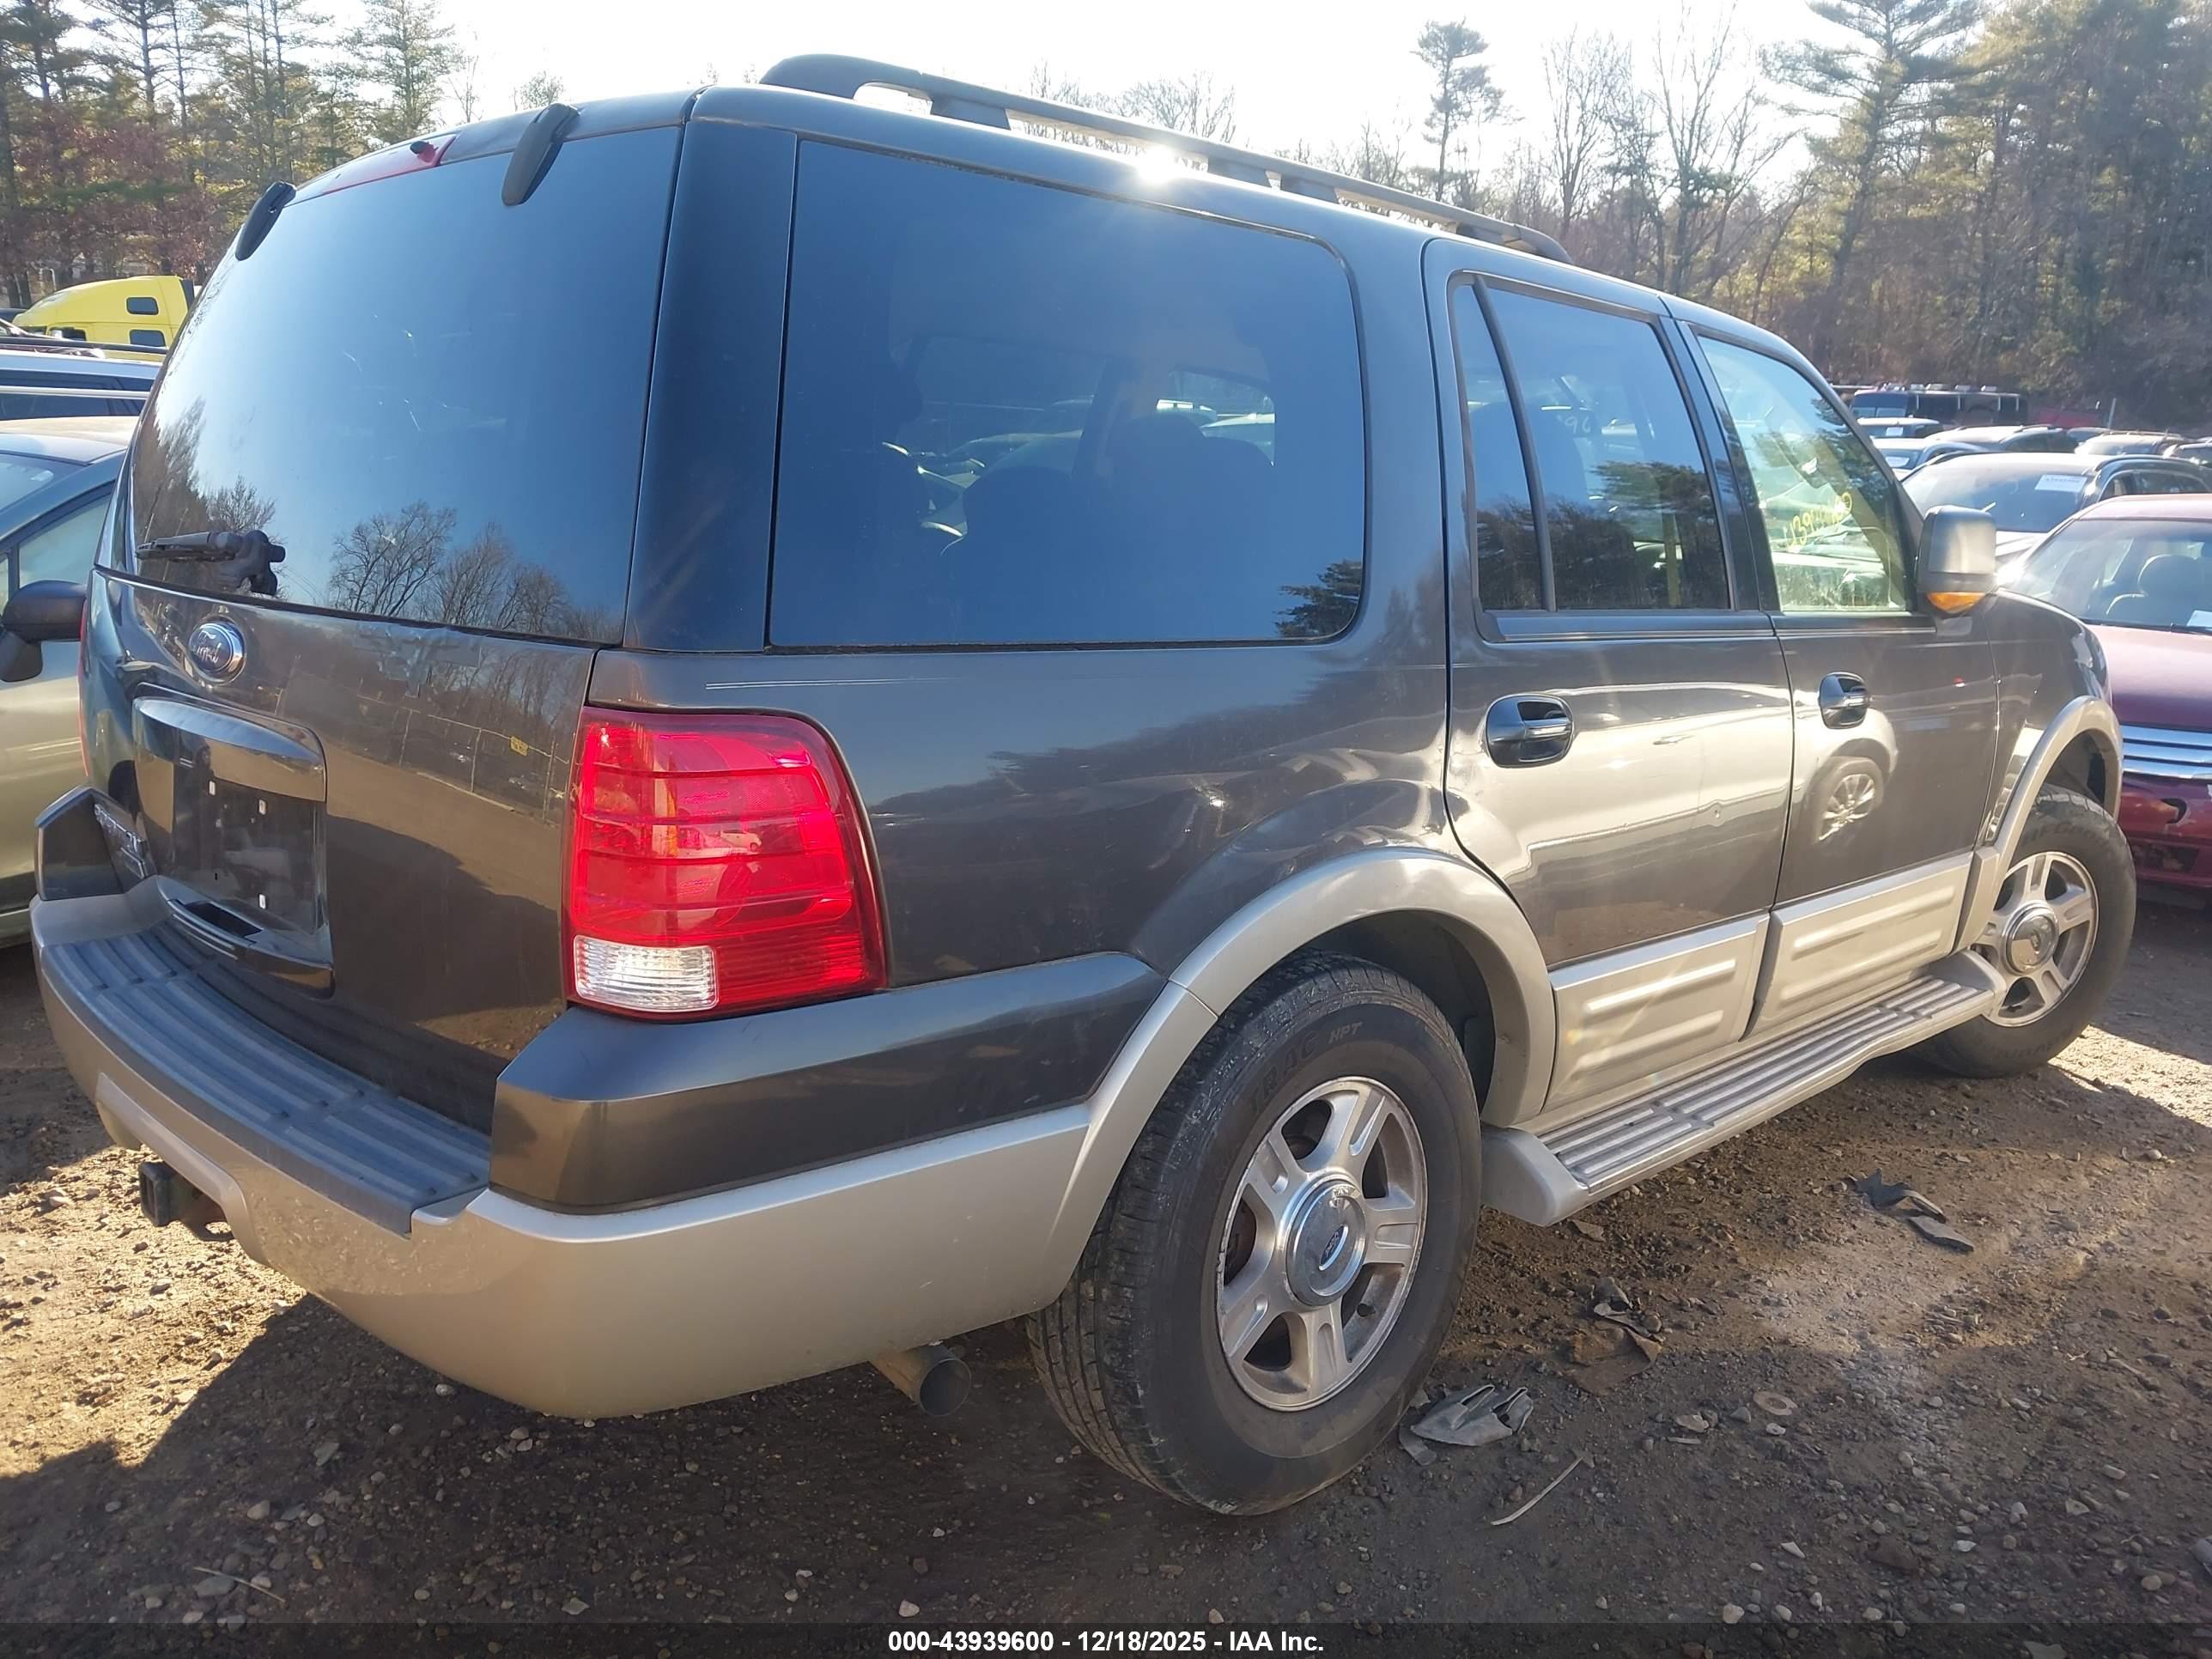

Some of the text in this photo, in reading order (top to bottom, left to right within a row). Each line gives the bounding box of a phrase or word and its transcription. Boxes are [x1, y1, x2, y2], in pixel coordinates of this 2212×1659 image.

[194, 630, 222, 664] Ford
[1249, 1022, 1364, 1115] TRAC HPT
